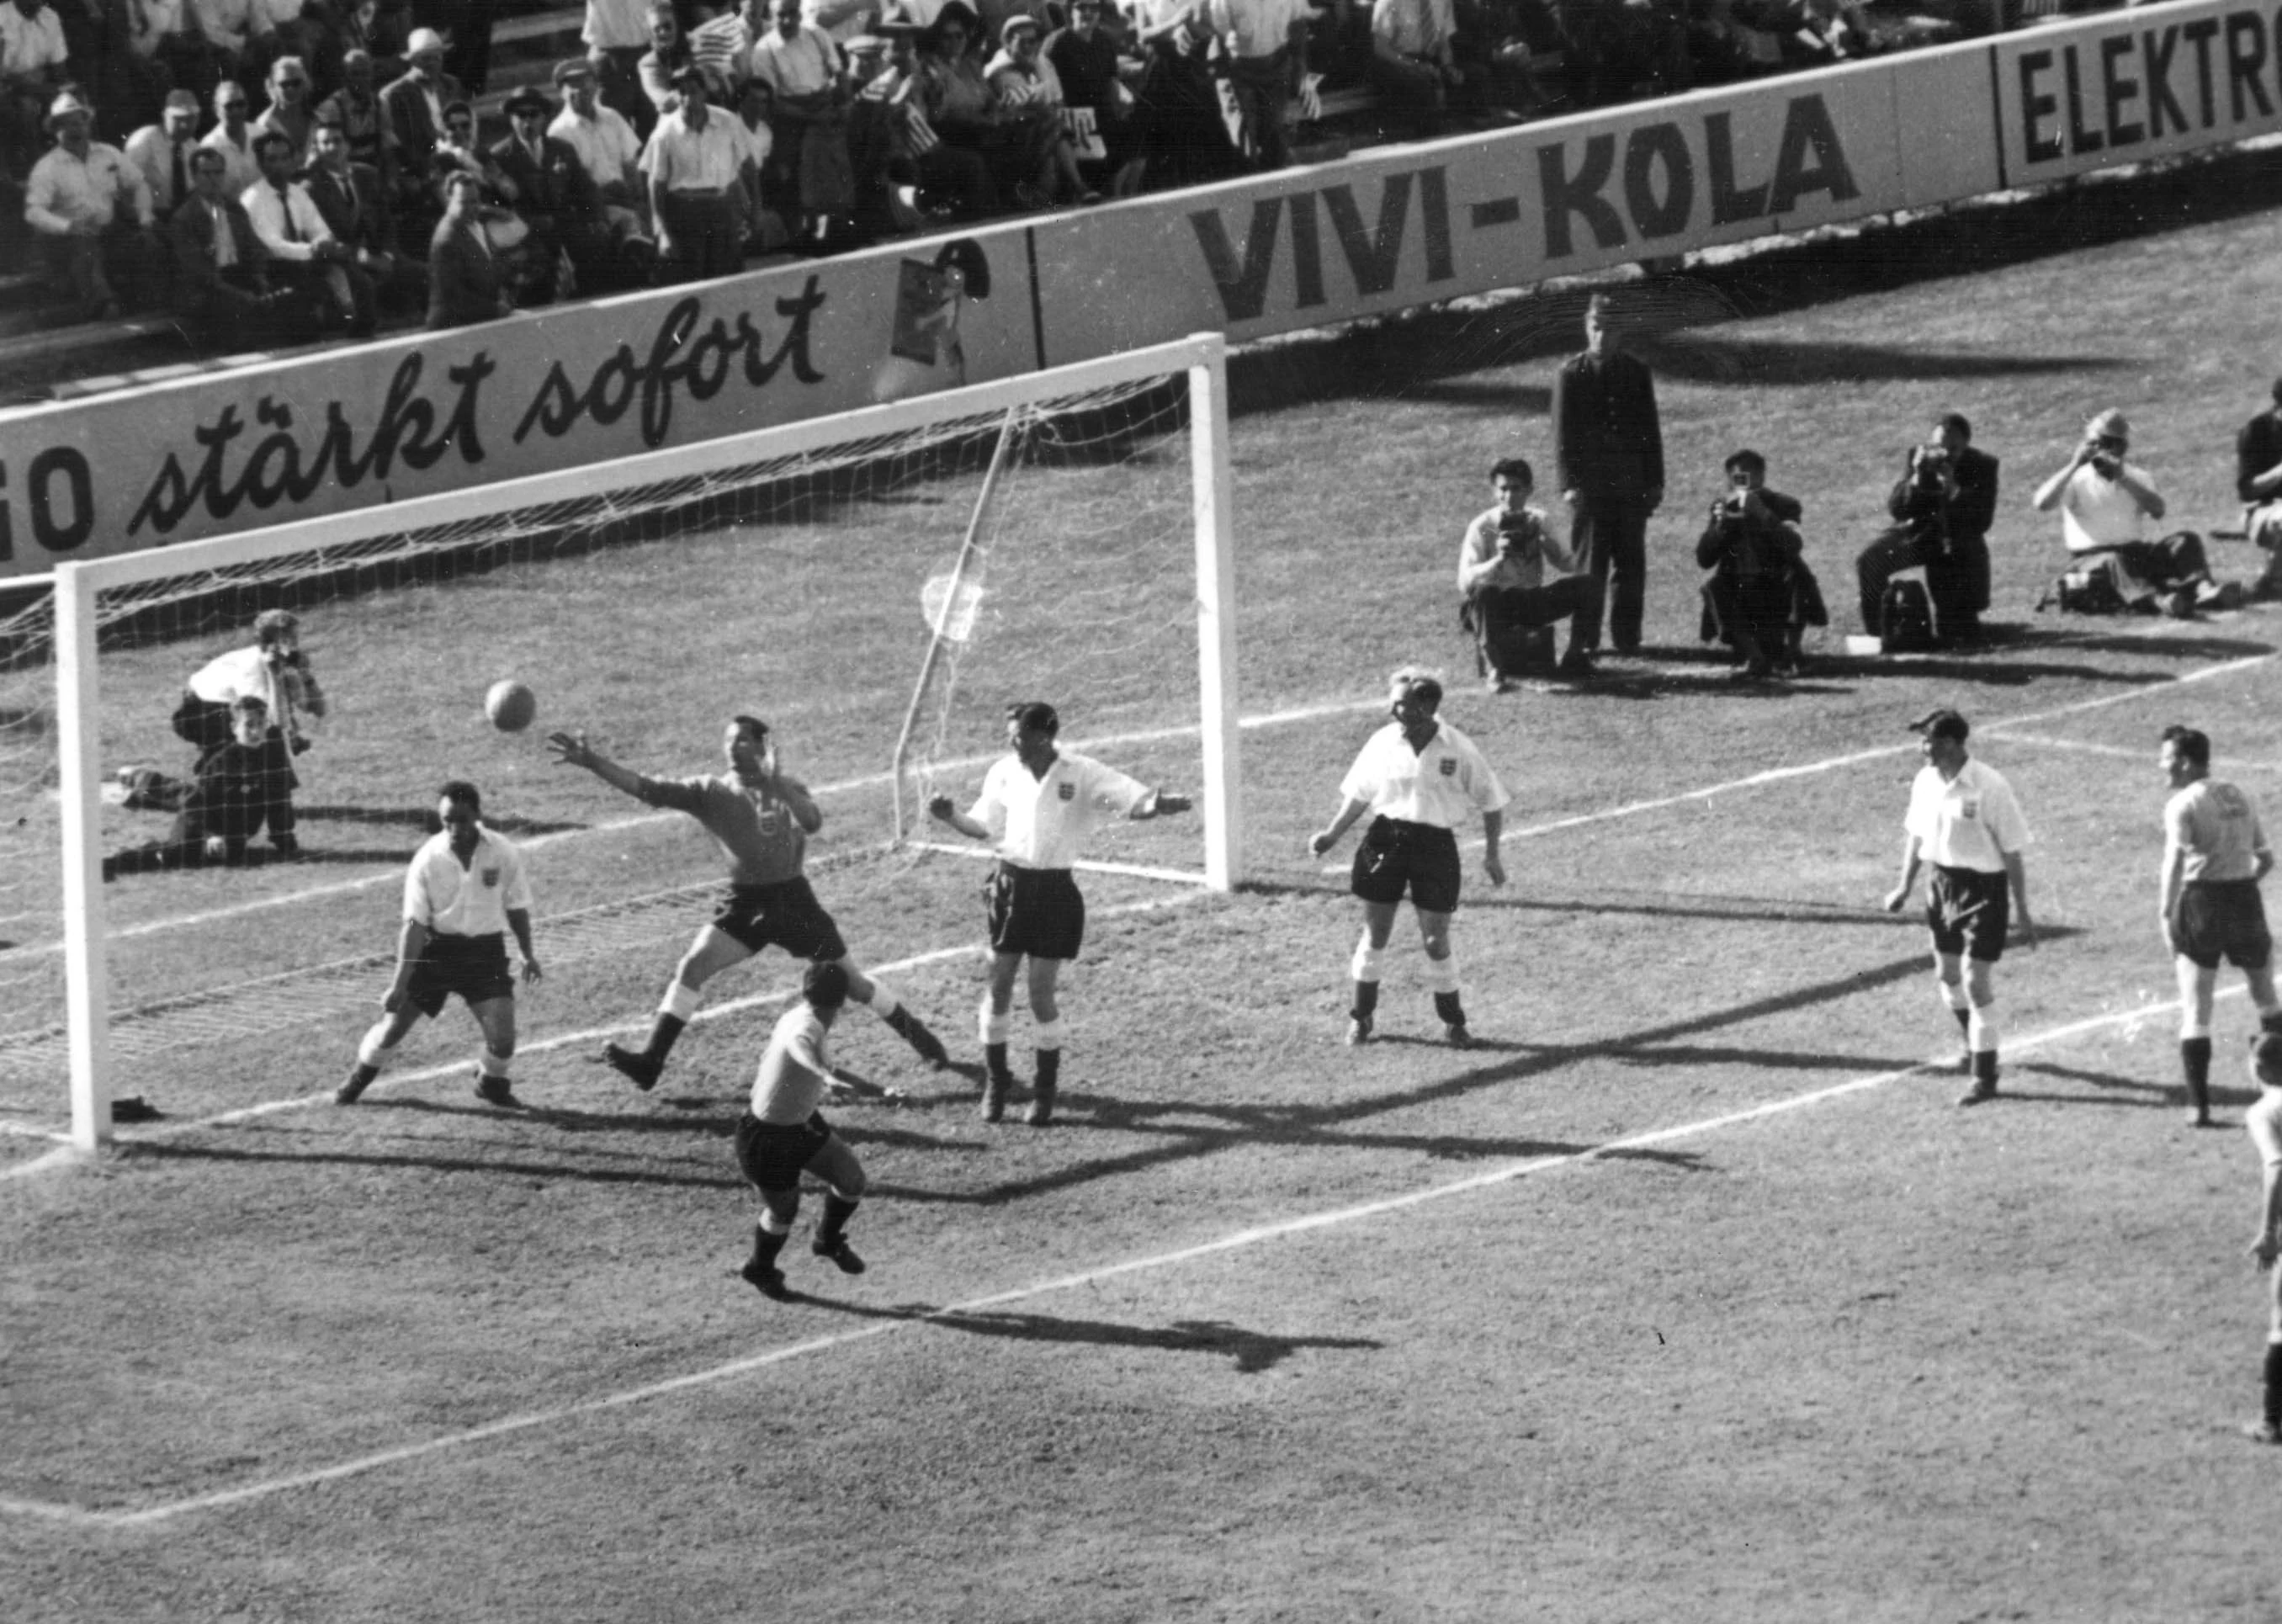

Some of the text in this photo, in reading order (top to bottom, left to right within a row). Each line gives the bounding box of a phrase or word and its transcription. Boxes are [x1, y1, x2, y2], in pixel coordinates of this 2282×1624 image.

[2019, 4, 2282, 165] ELEKTR
[0, 273, 827, 561] O stärkt sofort
